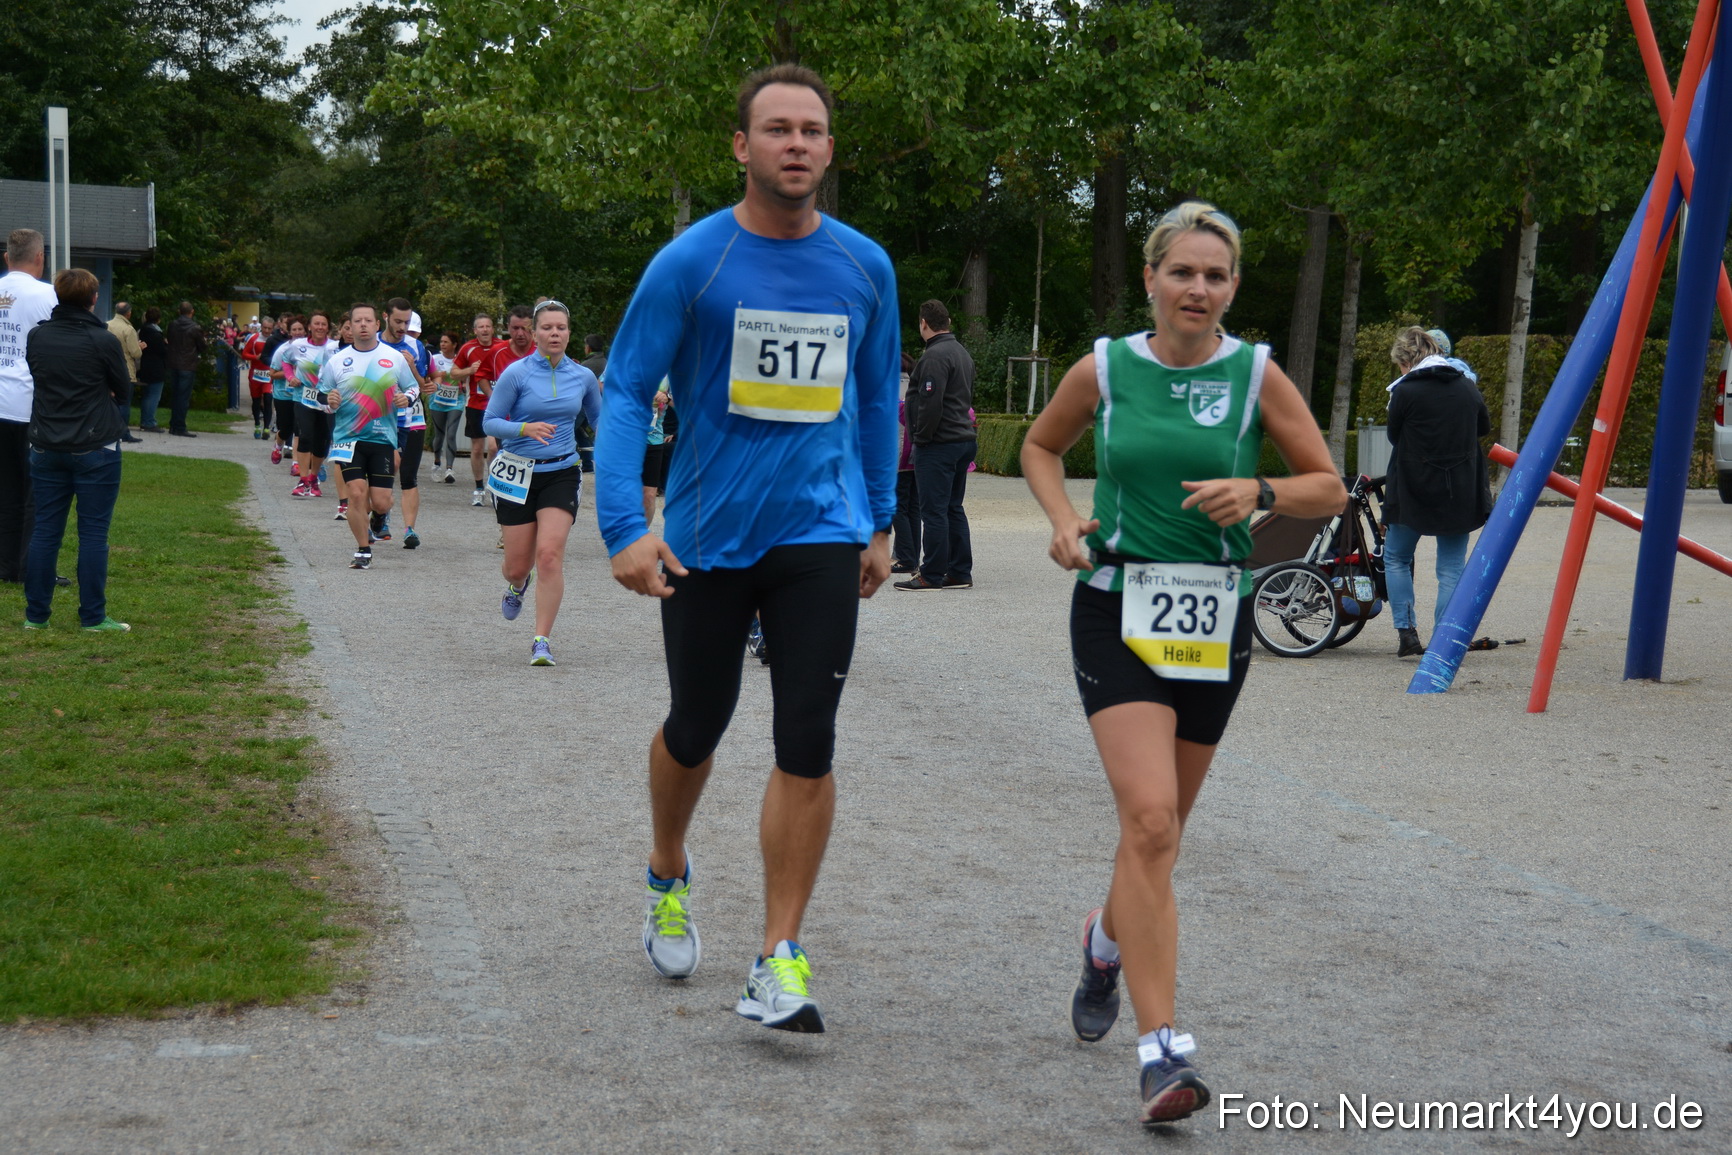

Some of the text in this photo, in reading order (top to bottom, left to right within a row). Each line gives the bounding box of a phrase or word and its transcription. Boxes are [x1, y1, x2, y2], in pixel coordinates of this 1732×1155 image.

[738, 320, 830, 336] PARTL Neumarkt
[757, 339, 827, 380] 517
[438, 389, 456, 398] 2637
[493, 481, 513, 493] Nadine
[1127, 575, 1222, 589] PARTL Neumarkt
[1150, 592, 1219, 636] 233
[1163, 645, 1202, 663] Heike
